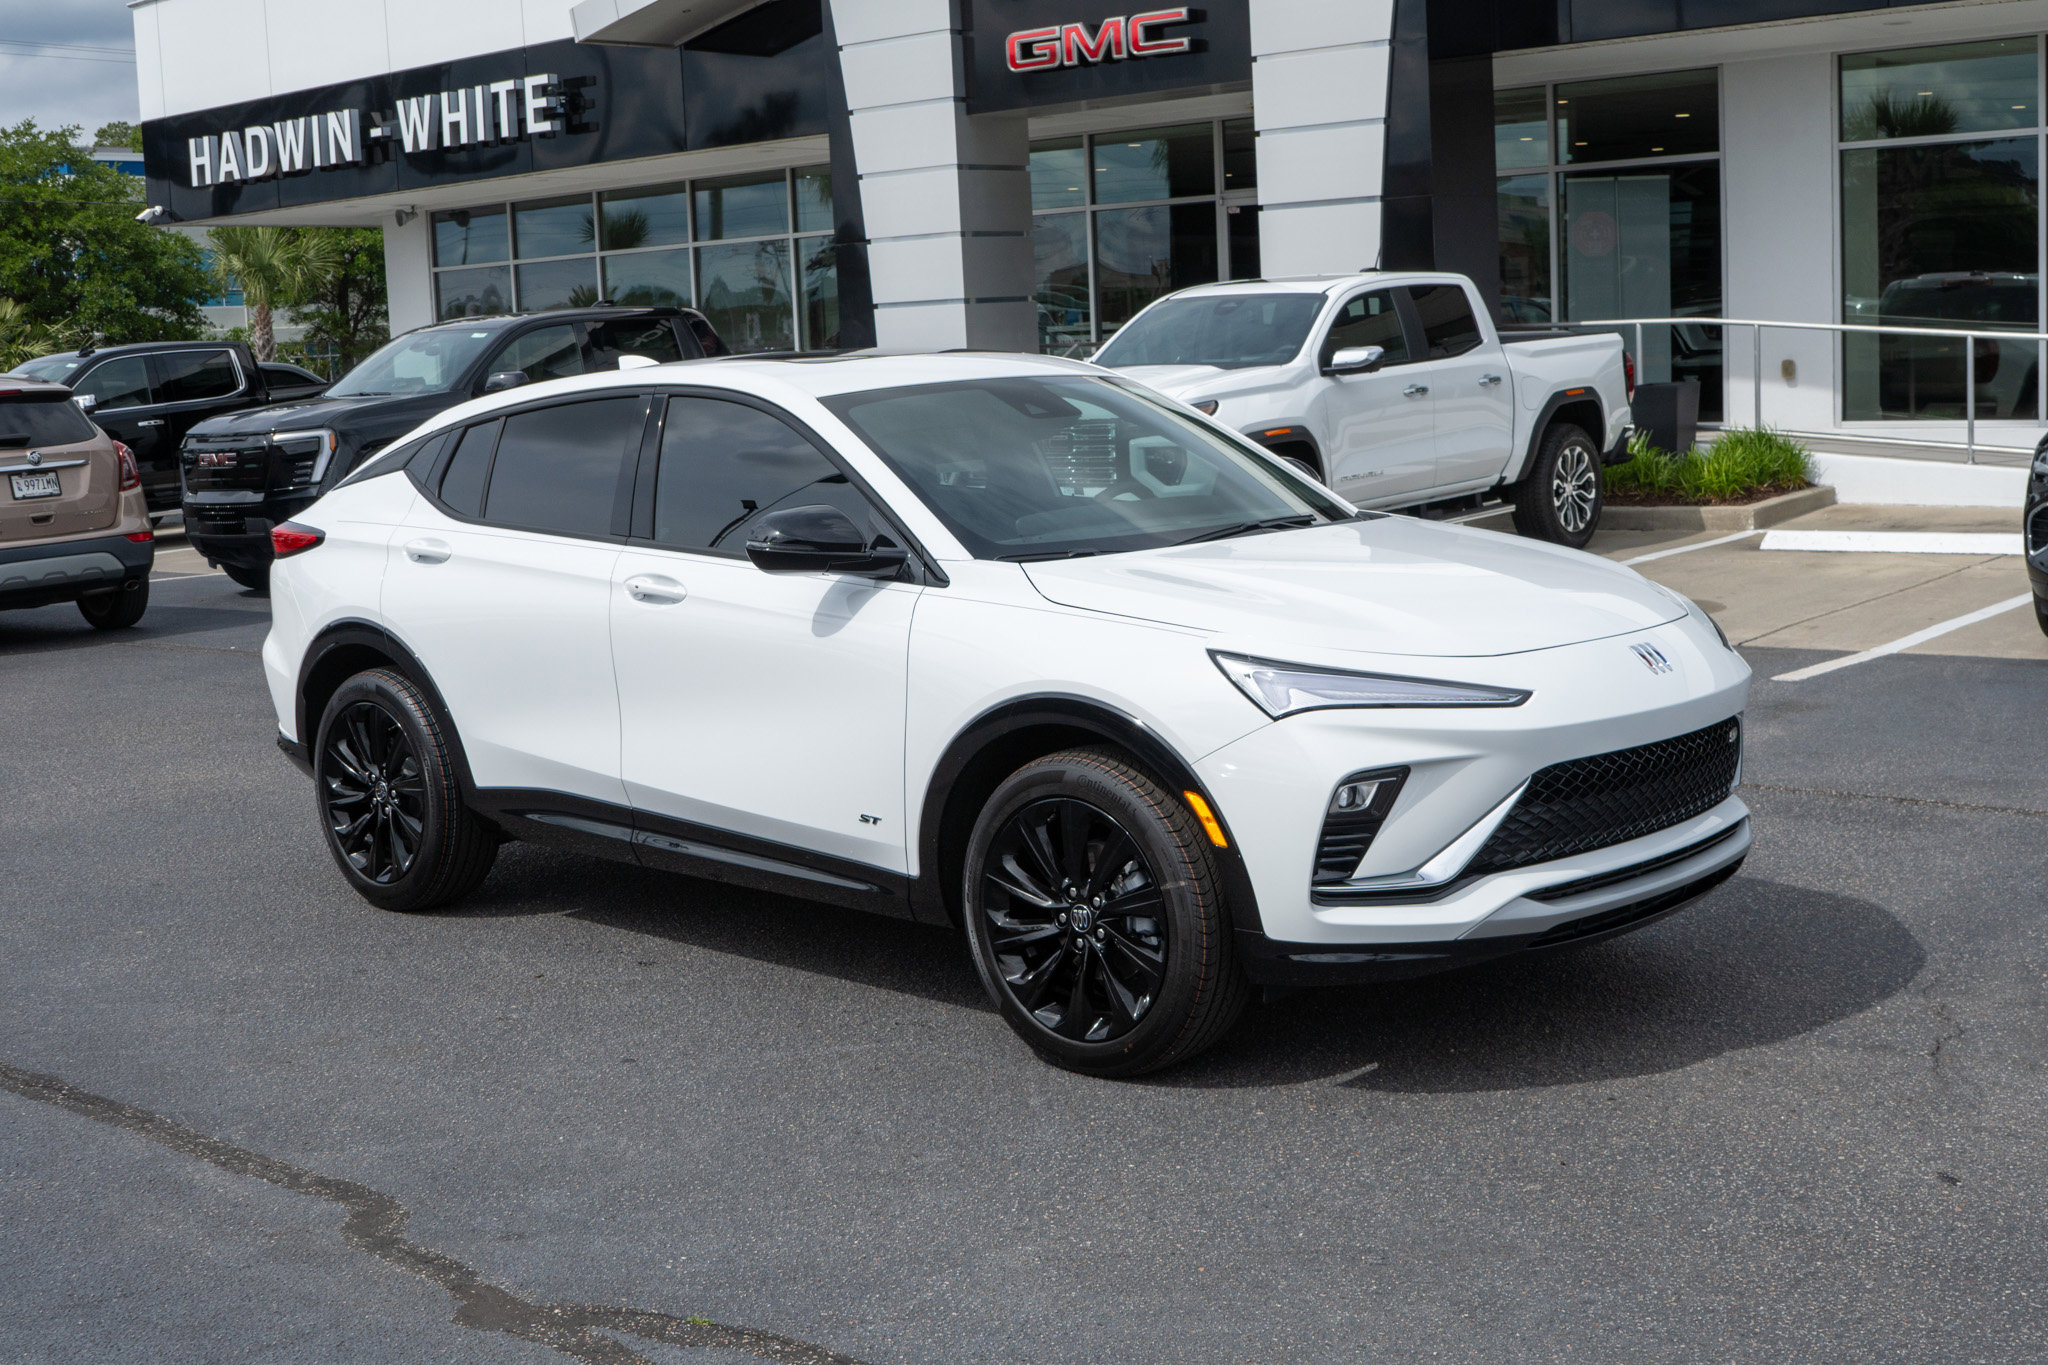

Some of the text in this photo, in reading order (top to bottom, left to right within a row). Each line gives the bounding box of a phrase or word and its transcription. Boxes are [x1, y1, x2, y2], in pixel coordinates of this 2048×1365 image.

[1006, 7, 1190, 72] GMC
[188, 108, 361, 187] HADWIN
[396, 73, 560, 153] WHITE
[199, 453, 237, 466] GMC
[859, 814, 882, 825] ST
